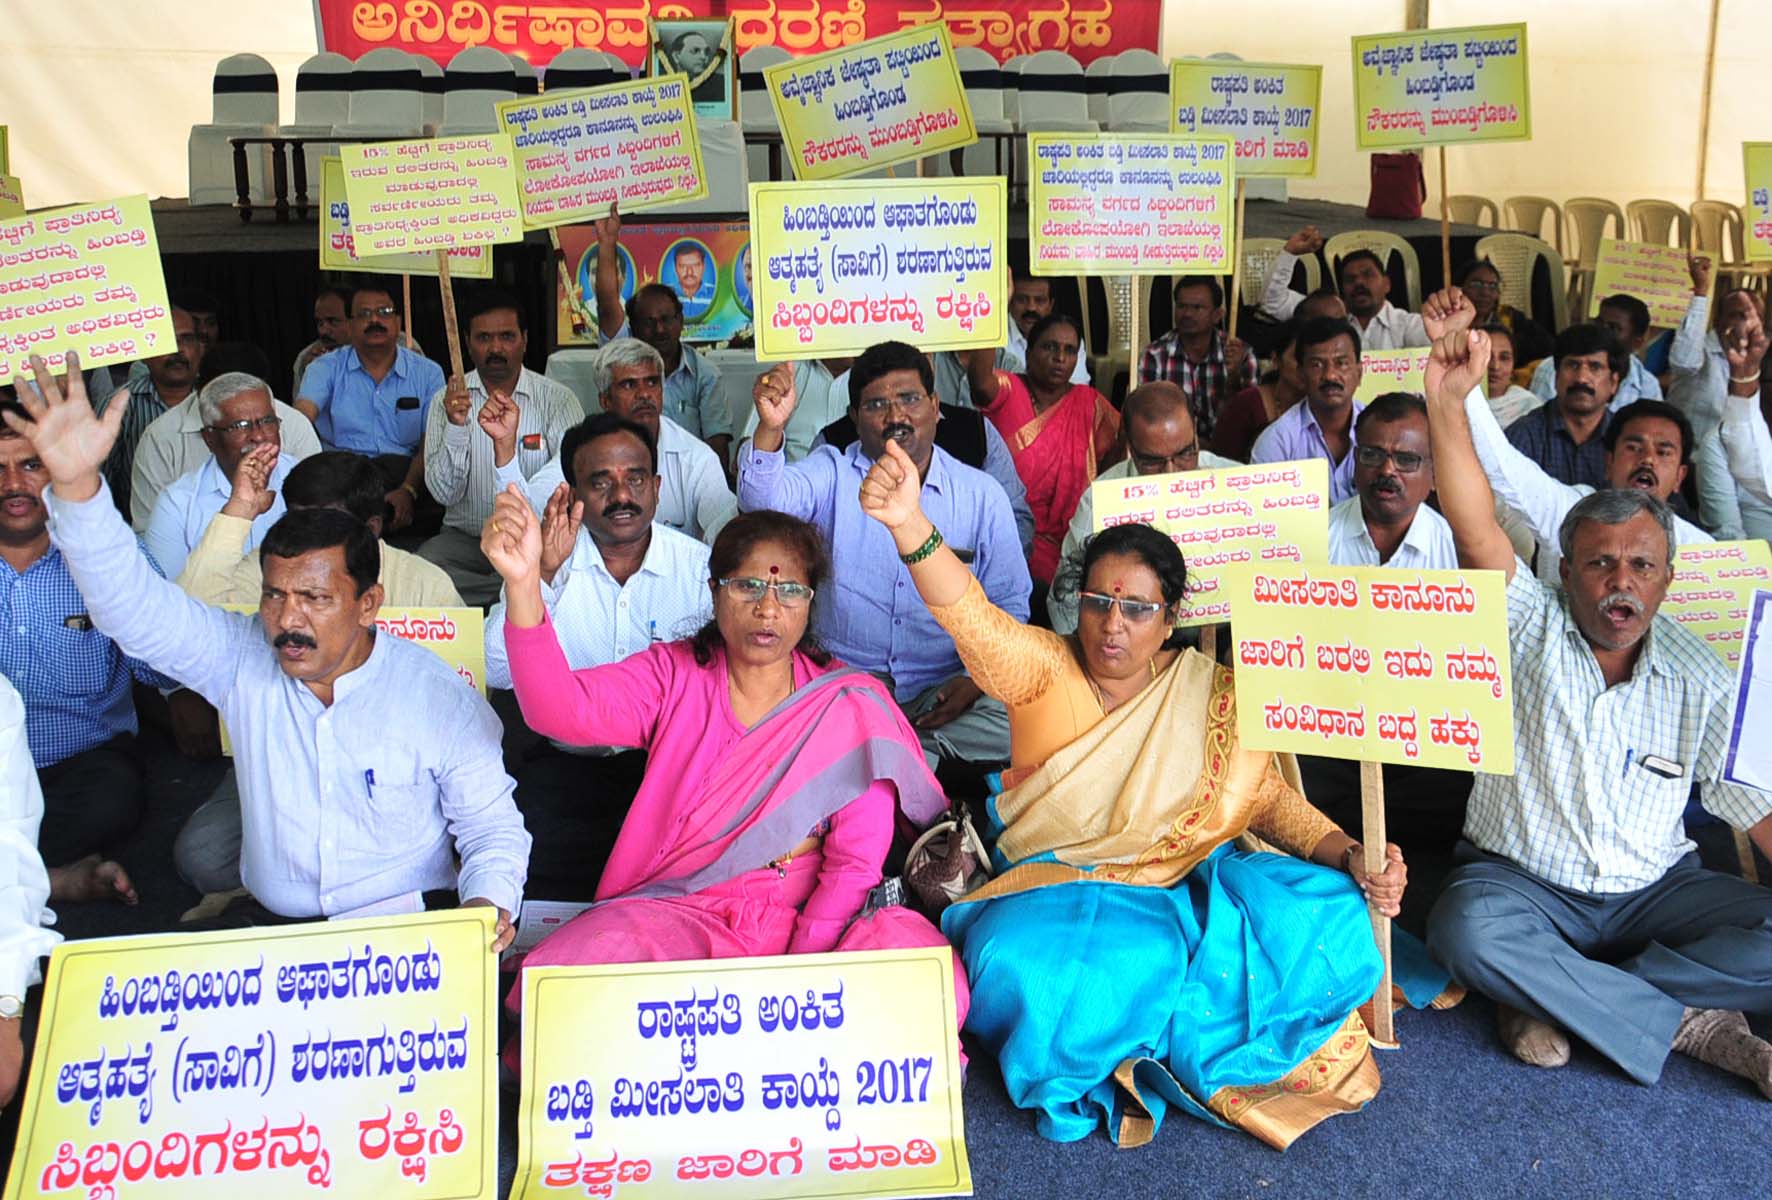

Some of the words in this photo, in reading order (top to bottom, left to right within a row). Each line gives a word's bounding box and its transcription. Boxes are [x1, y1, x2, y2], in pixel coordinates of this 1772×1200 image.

[659, 84, 682, 101] 2017
[1285, 108, 1312, 128] 2017
[1202, 144, 1225, 160] 2017
[1273, 137, 1309, 159] ಮಾಡಿ
[145, 331, 157, 348] ?
[772, 290, 925, 343] ಸಿಬ್ಬಂದಿಗಳನ್ನು
[936, 288, 992, 332] ರಕ್ಷಿಸಿ
[1254, 572, 1359, 608] ಮೀಸಲಾತಿ
[1371, 574, 1476, 614] ಕಾನೂನು
[1240, 634, 1305, 669] ಜಾರಿಗೆ
[1317, 639, 1371, 674] ಬರಲಿ
[1384, 643, 1434, 679] ಇದು
[1447, 647, 1504, 699] ನಮ್ಮ
[1265, 696, 1366, 740] ಸಂವಿಧಾನ
[1430, 710, 1483, 765] ಹಕ್ಕು
[637, 985, 742, 1072] ರಾಷ್ಟ್ರಪತಿ
[758, 978, 845, 1033] ಅಂಕಿತ
[172, 1029, 276, 1103] (ಸಾವಿಗೆ)
[291, 1015, 470, 1094] ಶರಣಾಗುತ್ತಿರುವ
[547, 1076, 594, 1140] ಬಡ್ತಿ
[611, 1066, 745, 1120] ಮೀಸಲಾತಿ
[762, 1056, 841, 1131] ಕಾಯ್ದೆ
[856, 1056, 933, 1105] 2017
[358, 1105, 464, 1183] ರಕ್ಷಿಸಿ
[545, 1147, 652, 1198] ತಕ್ಷಣ
[677, 1137, 803, 1182] ಜಾರಿಗೆ
[828, 1135, 937, 1171] ಮಾಡಿ
